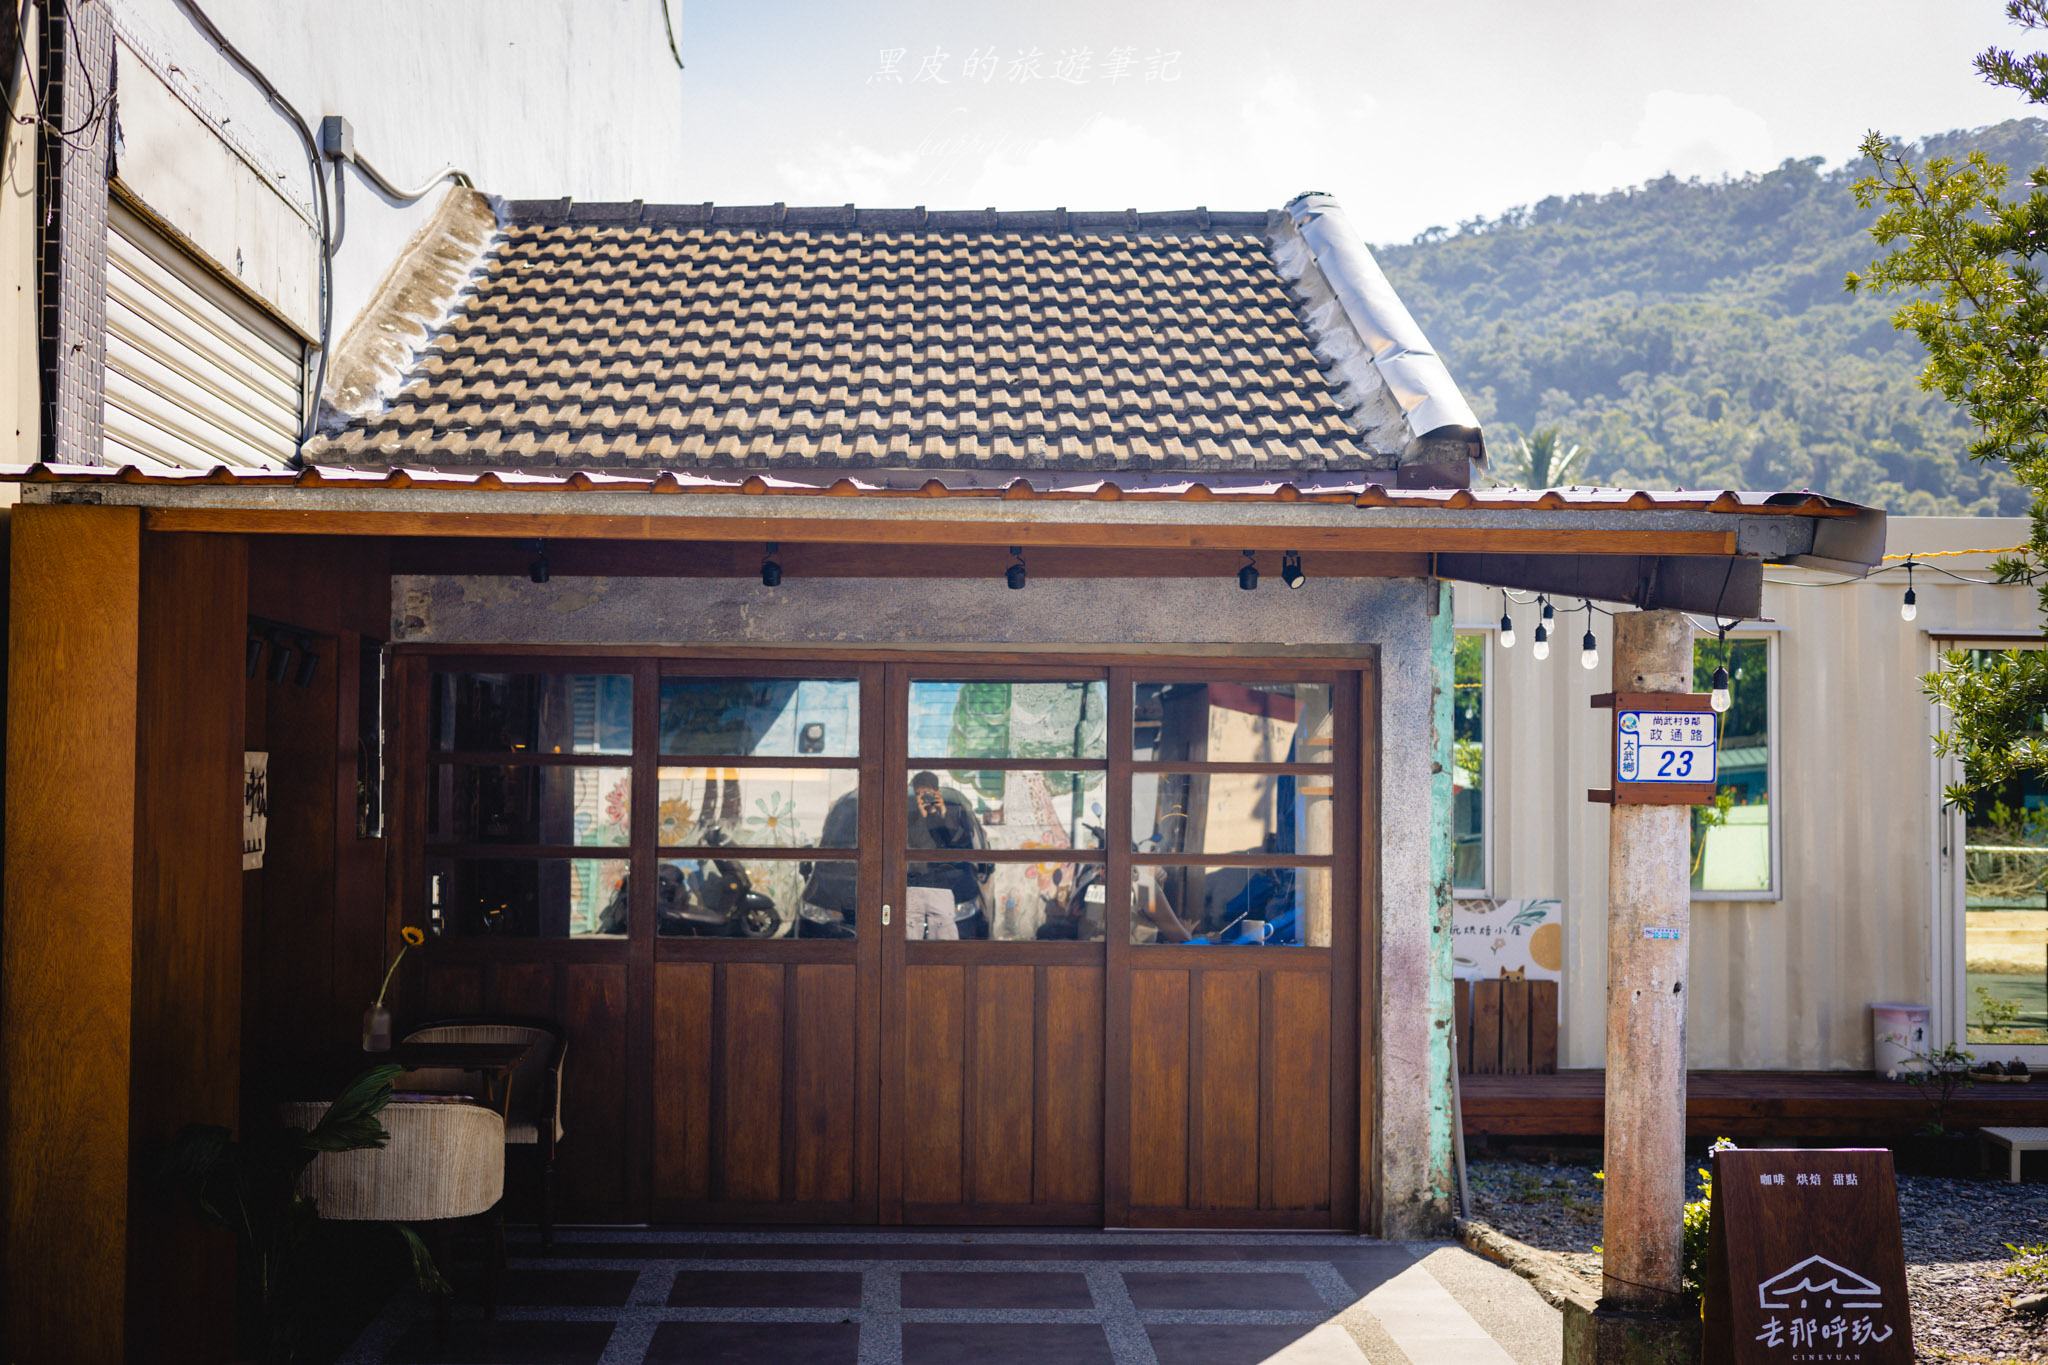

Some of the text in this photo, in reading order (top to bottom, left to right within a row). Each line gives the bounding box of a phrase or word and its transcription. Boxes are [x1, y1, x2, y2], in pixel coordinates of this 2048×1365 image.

[1650, 728, 1703, 742] 政通路
[1623, 740, 1634, 773] 大武鄉
[1657, 750, 1694, 777] 23
[1760, 1173, 1858, 1186] 咖啡 烘焙 甜點
[1756, 1315, 1893, 1348] 去那呼玩
